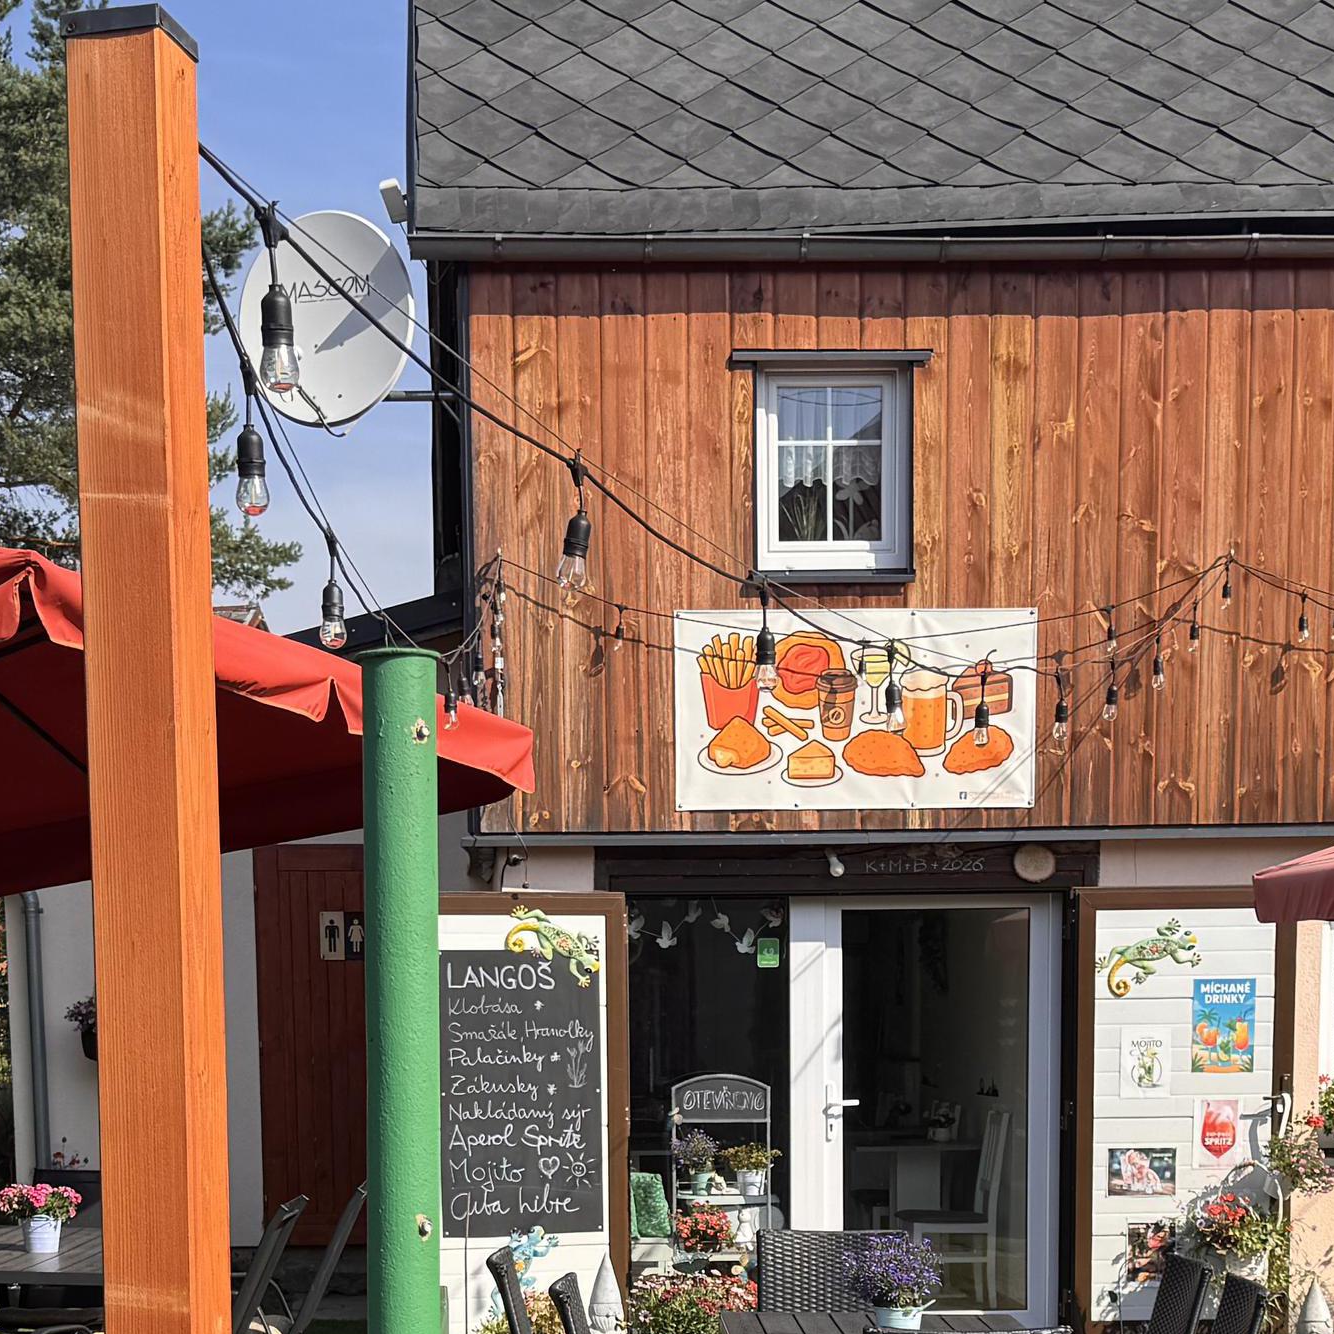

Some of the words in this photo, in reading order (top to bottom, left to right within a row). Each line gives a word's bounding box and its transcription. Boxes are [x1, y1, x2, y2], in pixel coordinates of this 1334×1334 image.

[447, 961, 556, 990] LANGOŠ
[1200, 981, 1251, 994] MÍCHANÉ
[448, 995, 523, 1016] Klobása
[1204, 994, 1247, 1004] DRINKY
[525, 1019, 595, 1052] Hranolky
[1131, 1040, 1163, 1051] MOJITO
[448, 1045, 545, 1072] Palačinky
[451, 1075, 539, 1101] Zákusky
[449, 1100, 555, 1129] Nakládaný
[562, 1104, 592, 1131] sýr
[449, 1124, 517, 1157] Aperol
[449, 1157, 525, 1192] Mojito
[451, 1190, 511, 1220] Cuba
[519, 1183, 580, 1214] Libre
